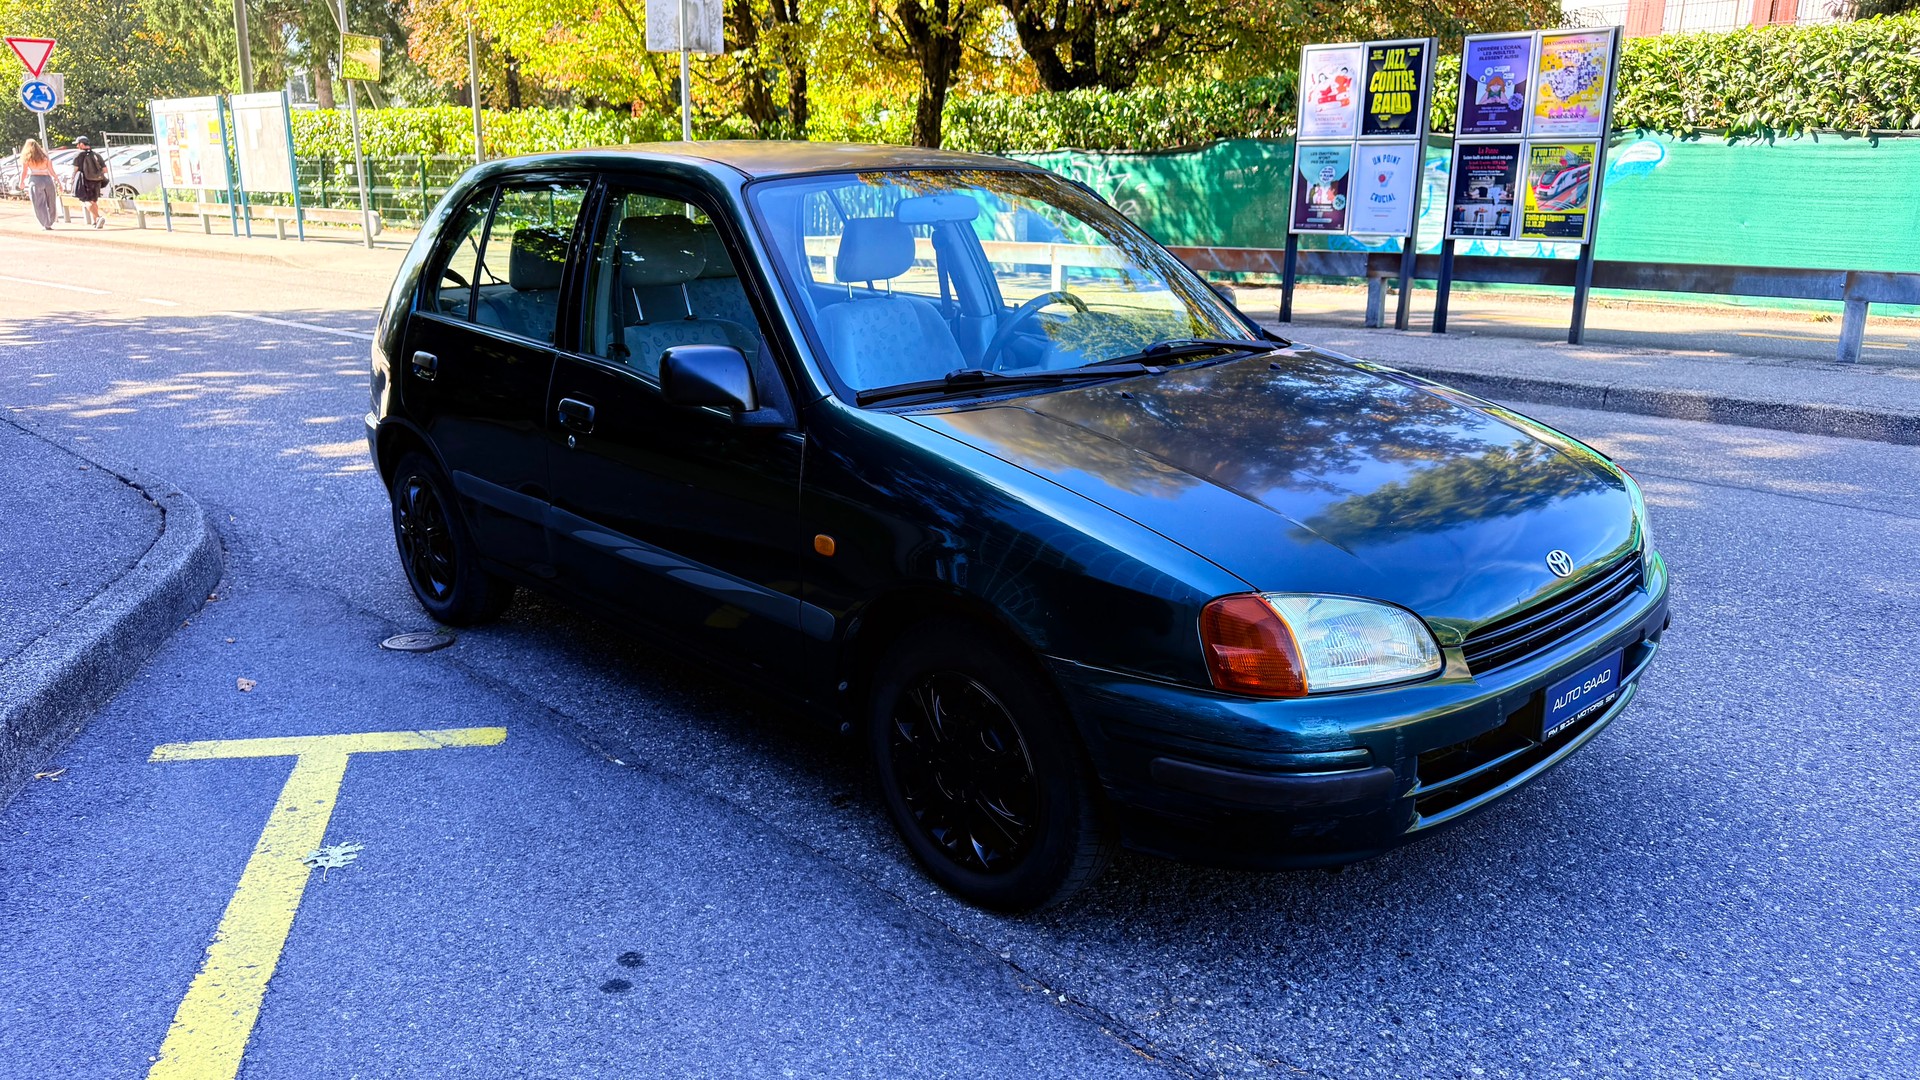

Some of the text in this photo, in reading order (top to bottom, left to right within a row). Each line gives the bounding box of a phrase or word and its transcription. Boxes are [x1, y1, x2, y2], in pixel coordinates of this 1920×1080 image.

[1383, 48, 1407, 70] JAZZ
[1369, 70, 1417, 93] CONTRE
[1370, 92, 1412, 115] BAND
[1372, 154, 1401, 165] UN POINT
[1370, 192, 1396, 203] CRUCIAL
[1552, 669, 1611, 713] AUTO SAAD
[1577, 700, 1604, 720] MOTORS
